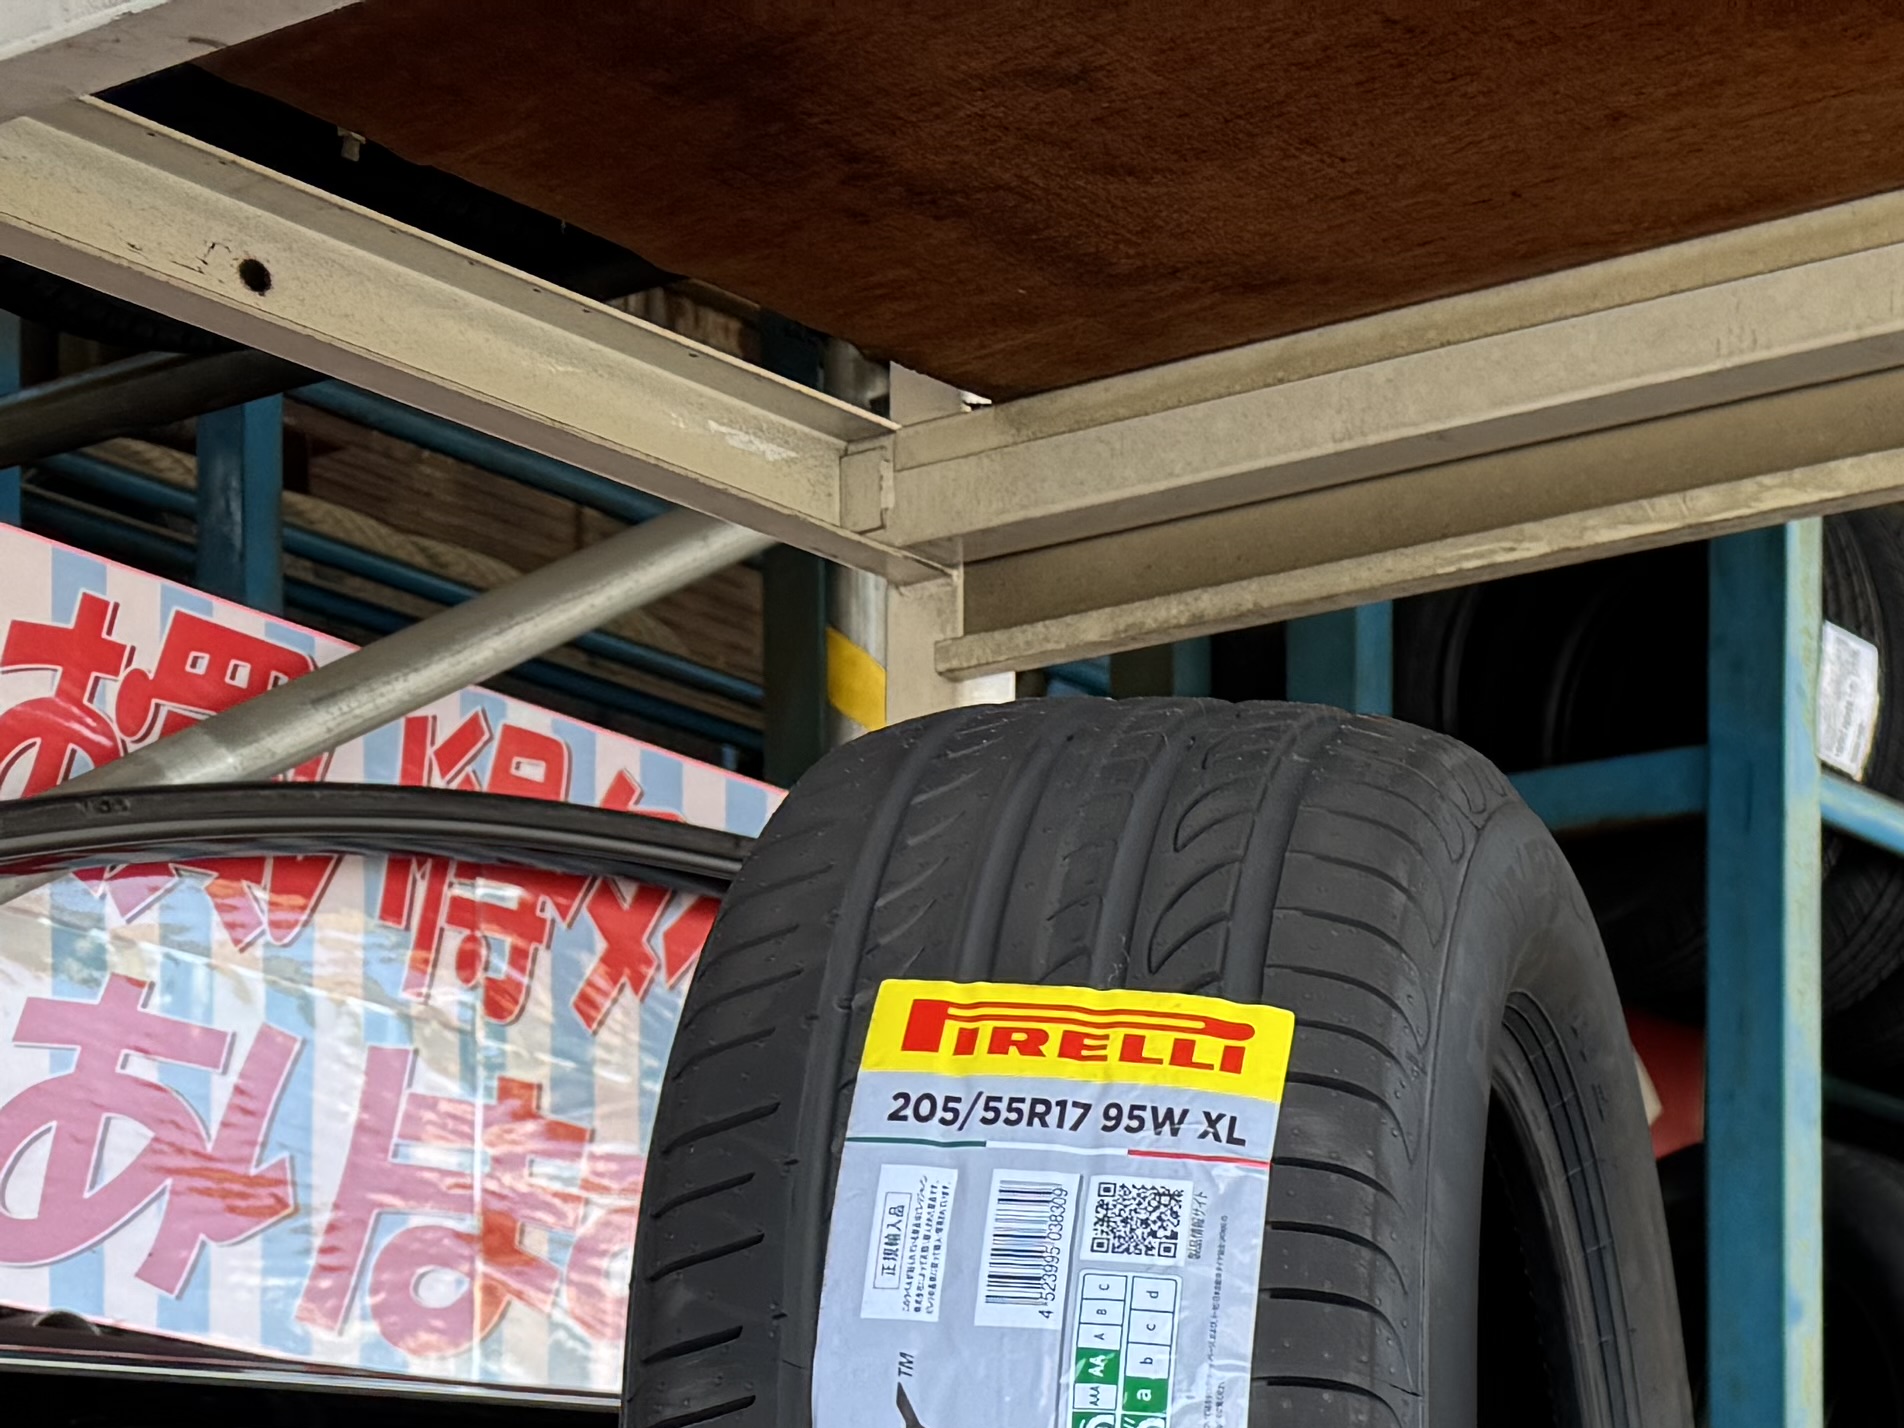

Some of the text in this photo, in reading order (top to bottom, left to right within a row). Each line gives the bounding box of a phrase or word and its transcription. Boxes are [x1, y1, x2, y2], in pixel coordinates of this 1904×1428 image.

[902, 998, 1255, 1074] PIRELLI
[888, 1091, 1246, 1146] 205/55R17 95W XL
[880, 1203, 905, 1277] 正規輸入品
[1040, 1188, 1066, 1319] 4 523995 038309
[1090, 1354, 1107, 1377] AA
[1137, 1387, 1153, 1401] a
